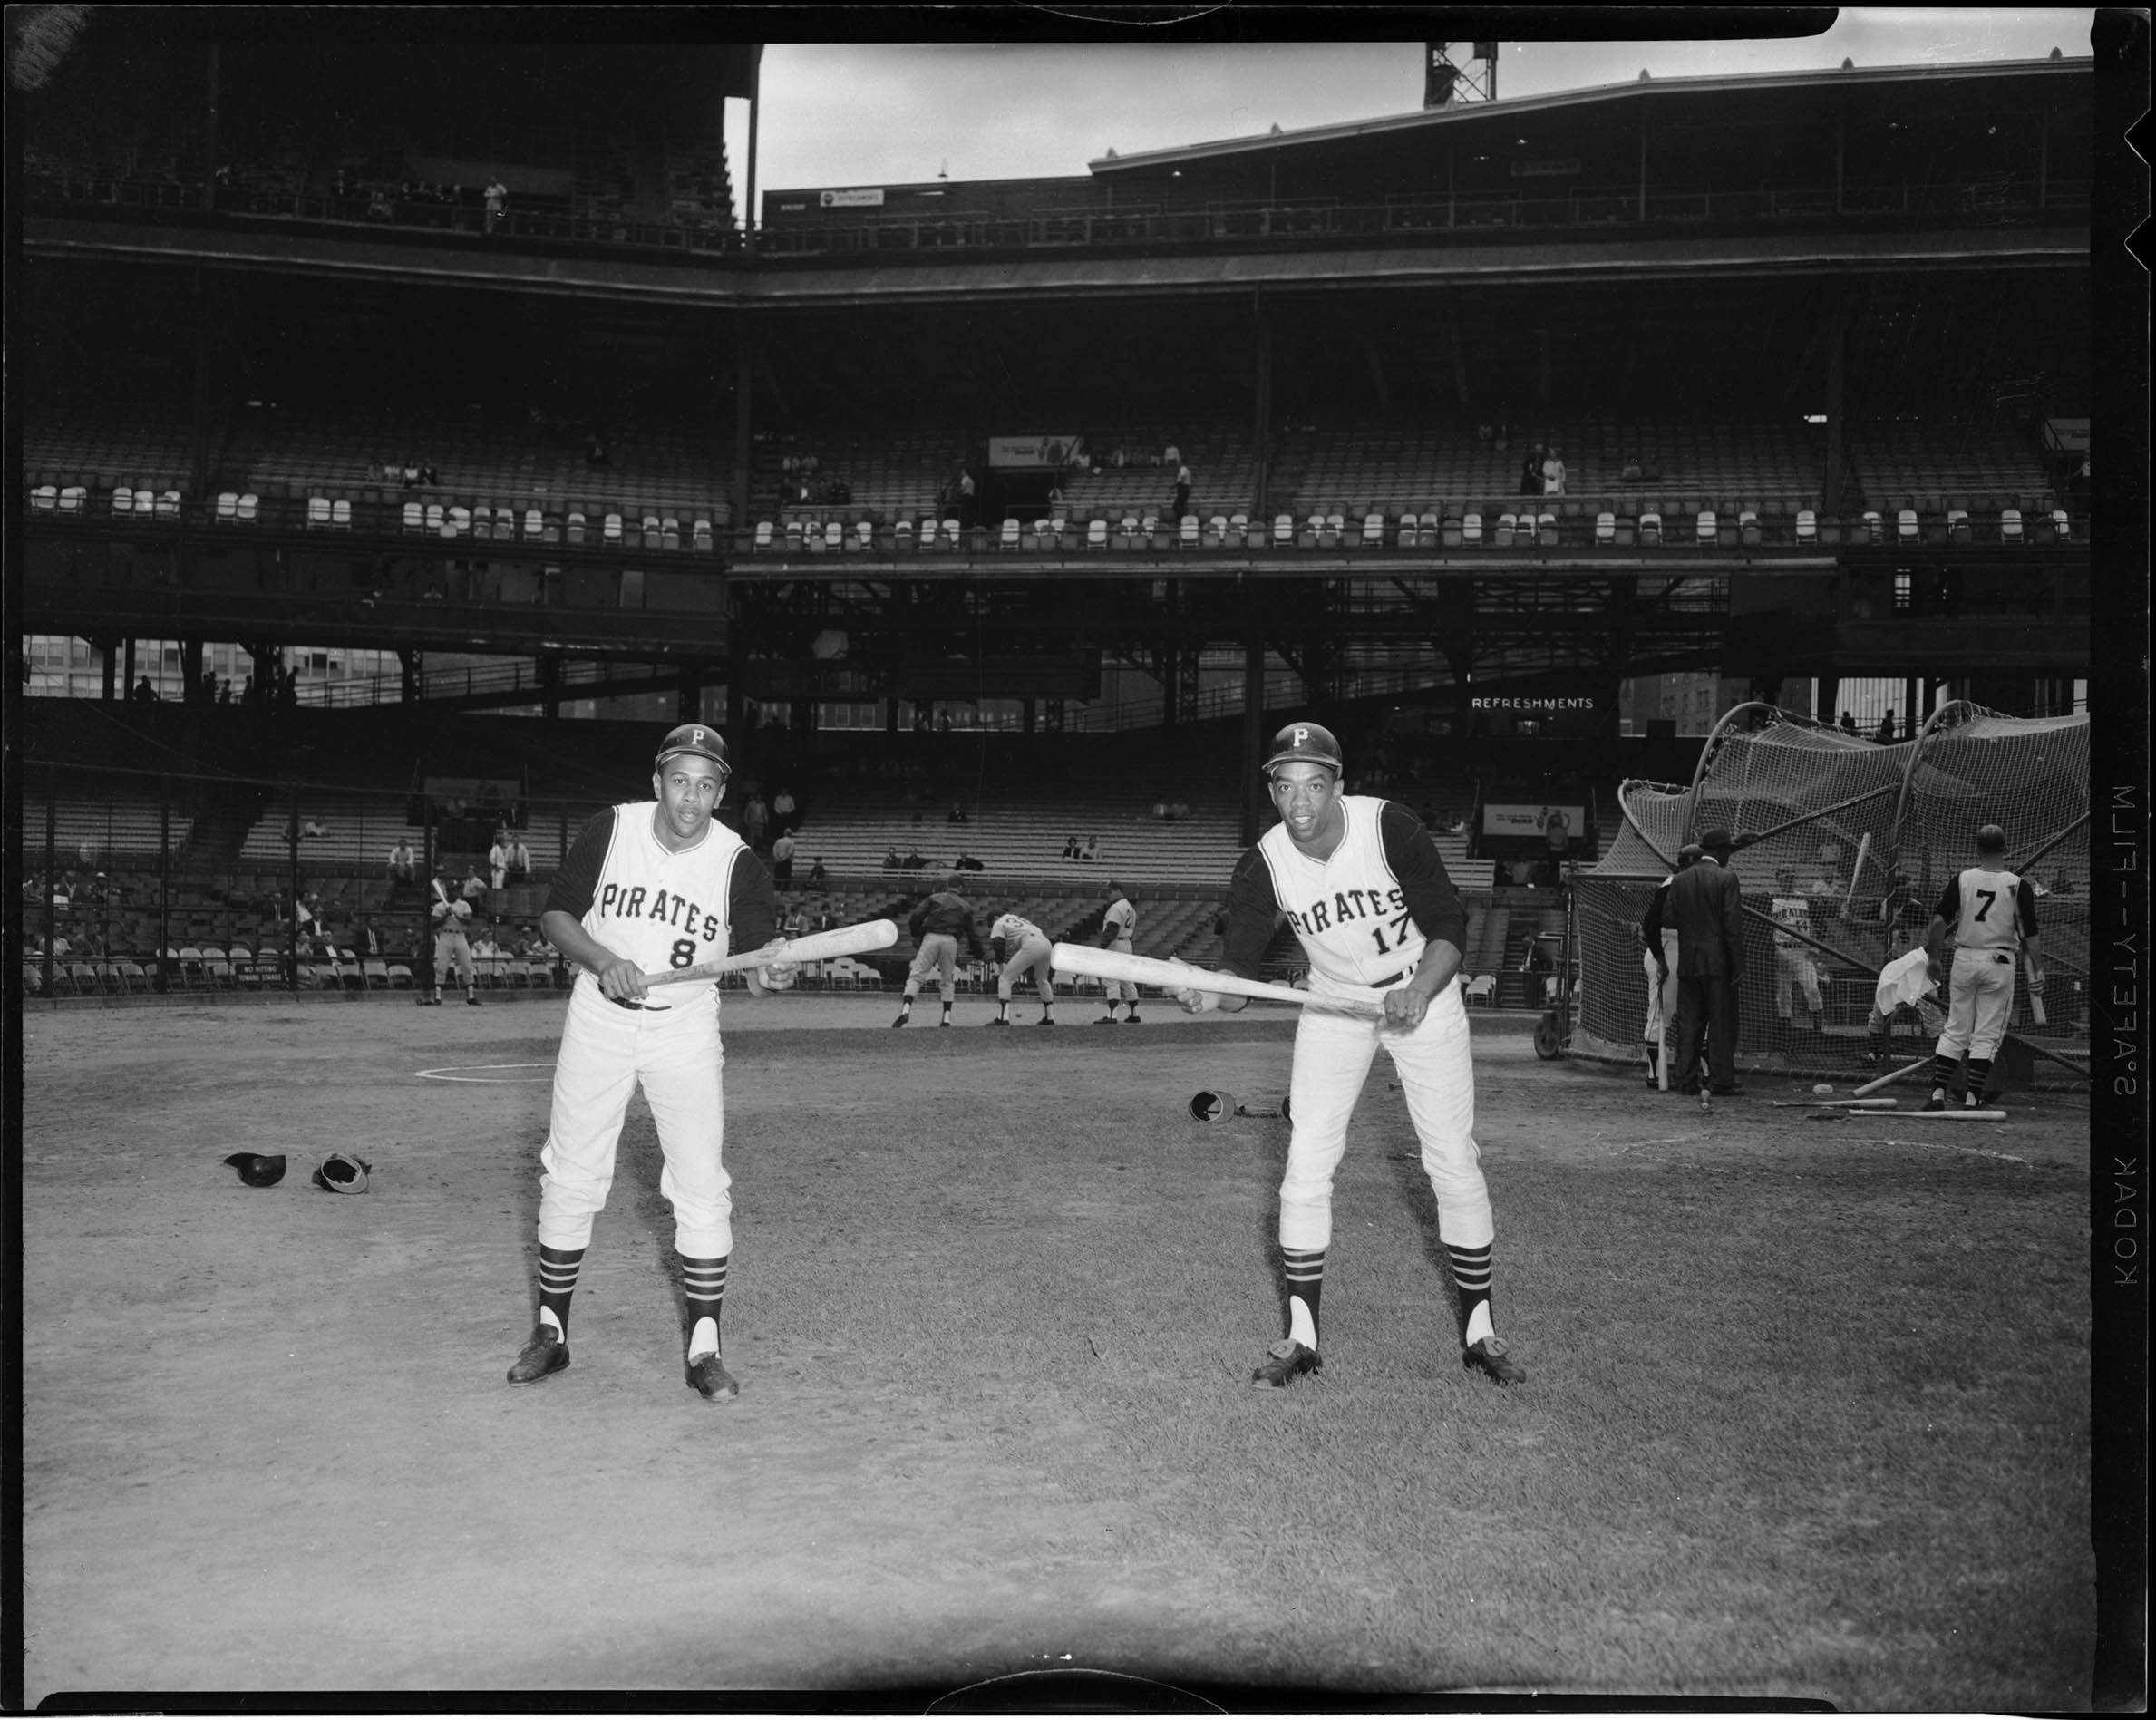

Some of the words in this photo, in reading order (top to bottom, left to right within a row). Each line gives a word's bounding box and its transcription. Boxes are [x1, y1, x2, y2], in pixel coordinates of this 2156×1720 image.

[1471, 697, 1594, 709] REFRESHMENTS
[692, 729, 704, 744] P
[1293, 728, 1309, 747] P
[601, 883, 719, 942] PIRATES
[1287, 889, 1405, 935] PIRATES
[1974, 889, 1996, 922] 7
[1372, 908, 1411, 956] 17
[244, 965, 254, 973] NO
[669, 938, 697, 969] 8
